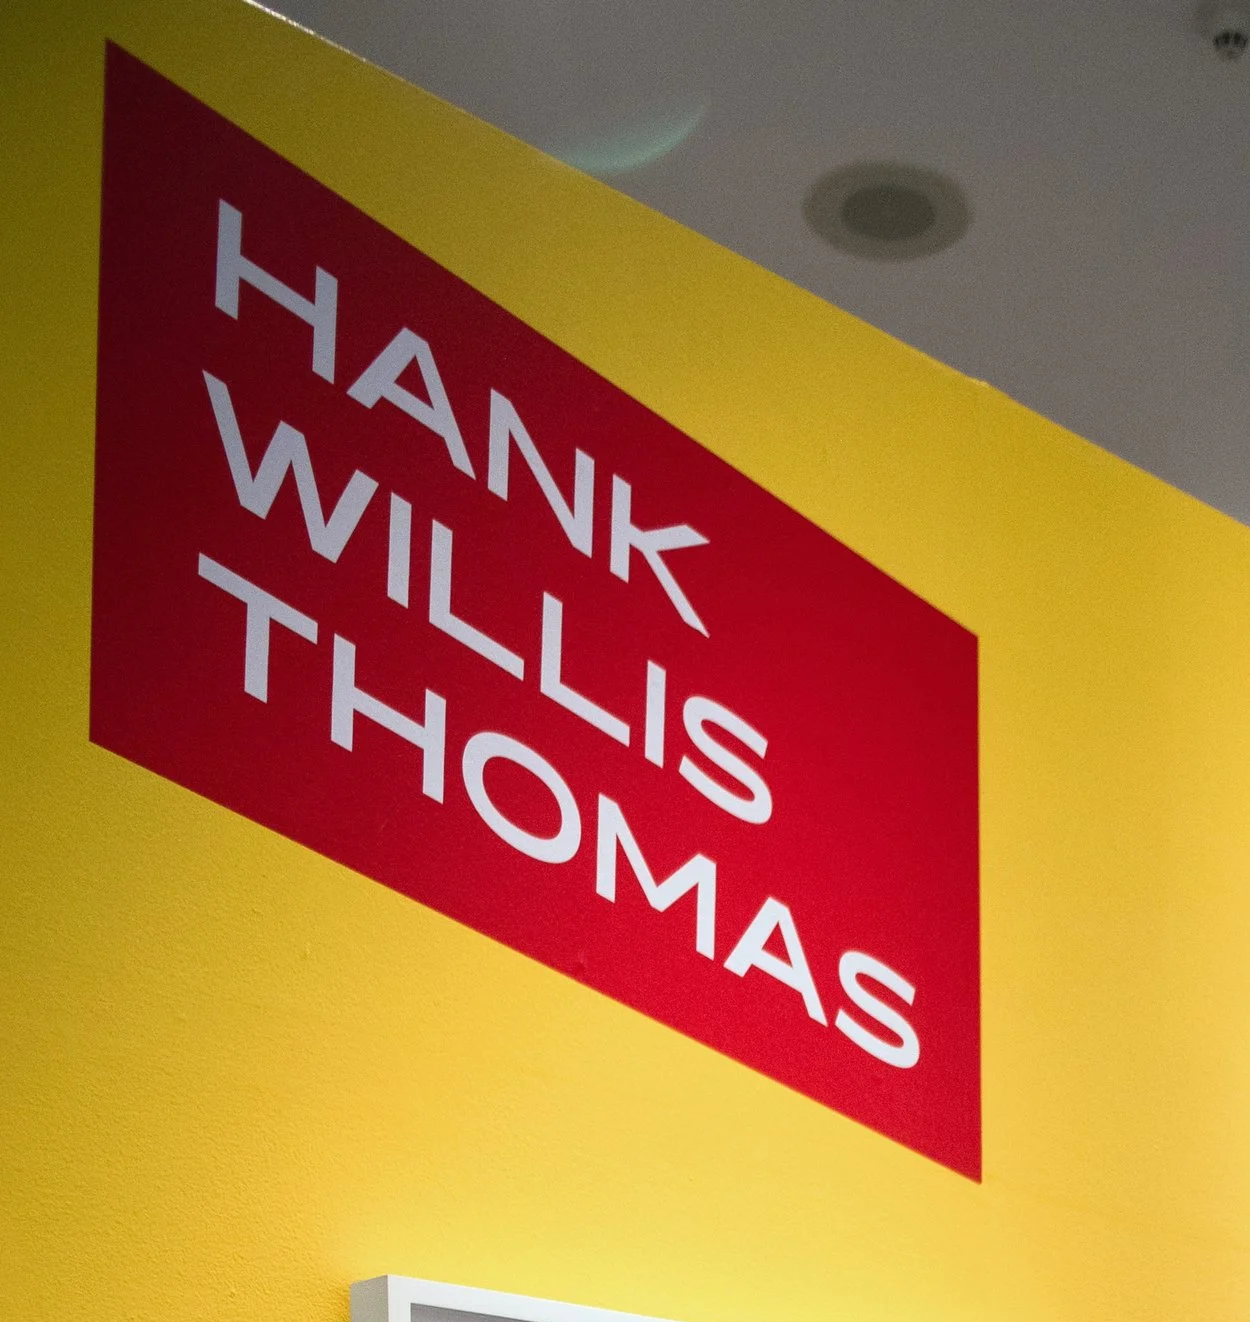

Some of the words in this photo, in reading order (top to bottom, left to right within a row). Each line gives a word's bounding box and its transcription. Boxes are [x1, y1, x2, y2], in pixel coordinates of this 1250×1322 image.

[202, 369, 773, 825] WILLIS
[214, 199, 710, 638] HANK
[198, 553, 921, 1069] THOMAS
